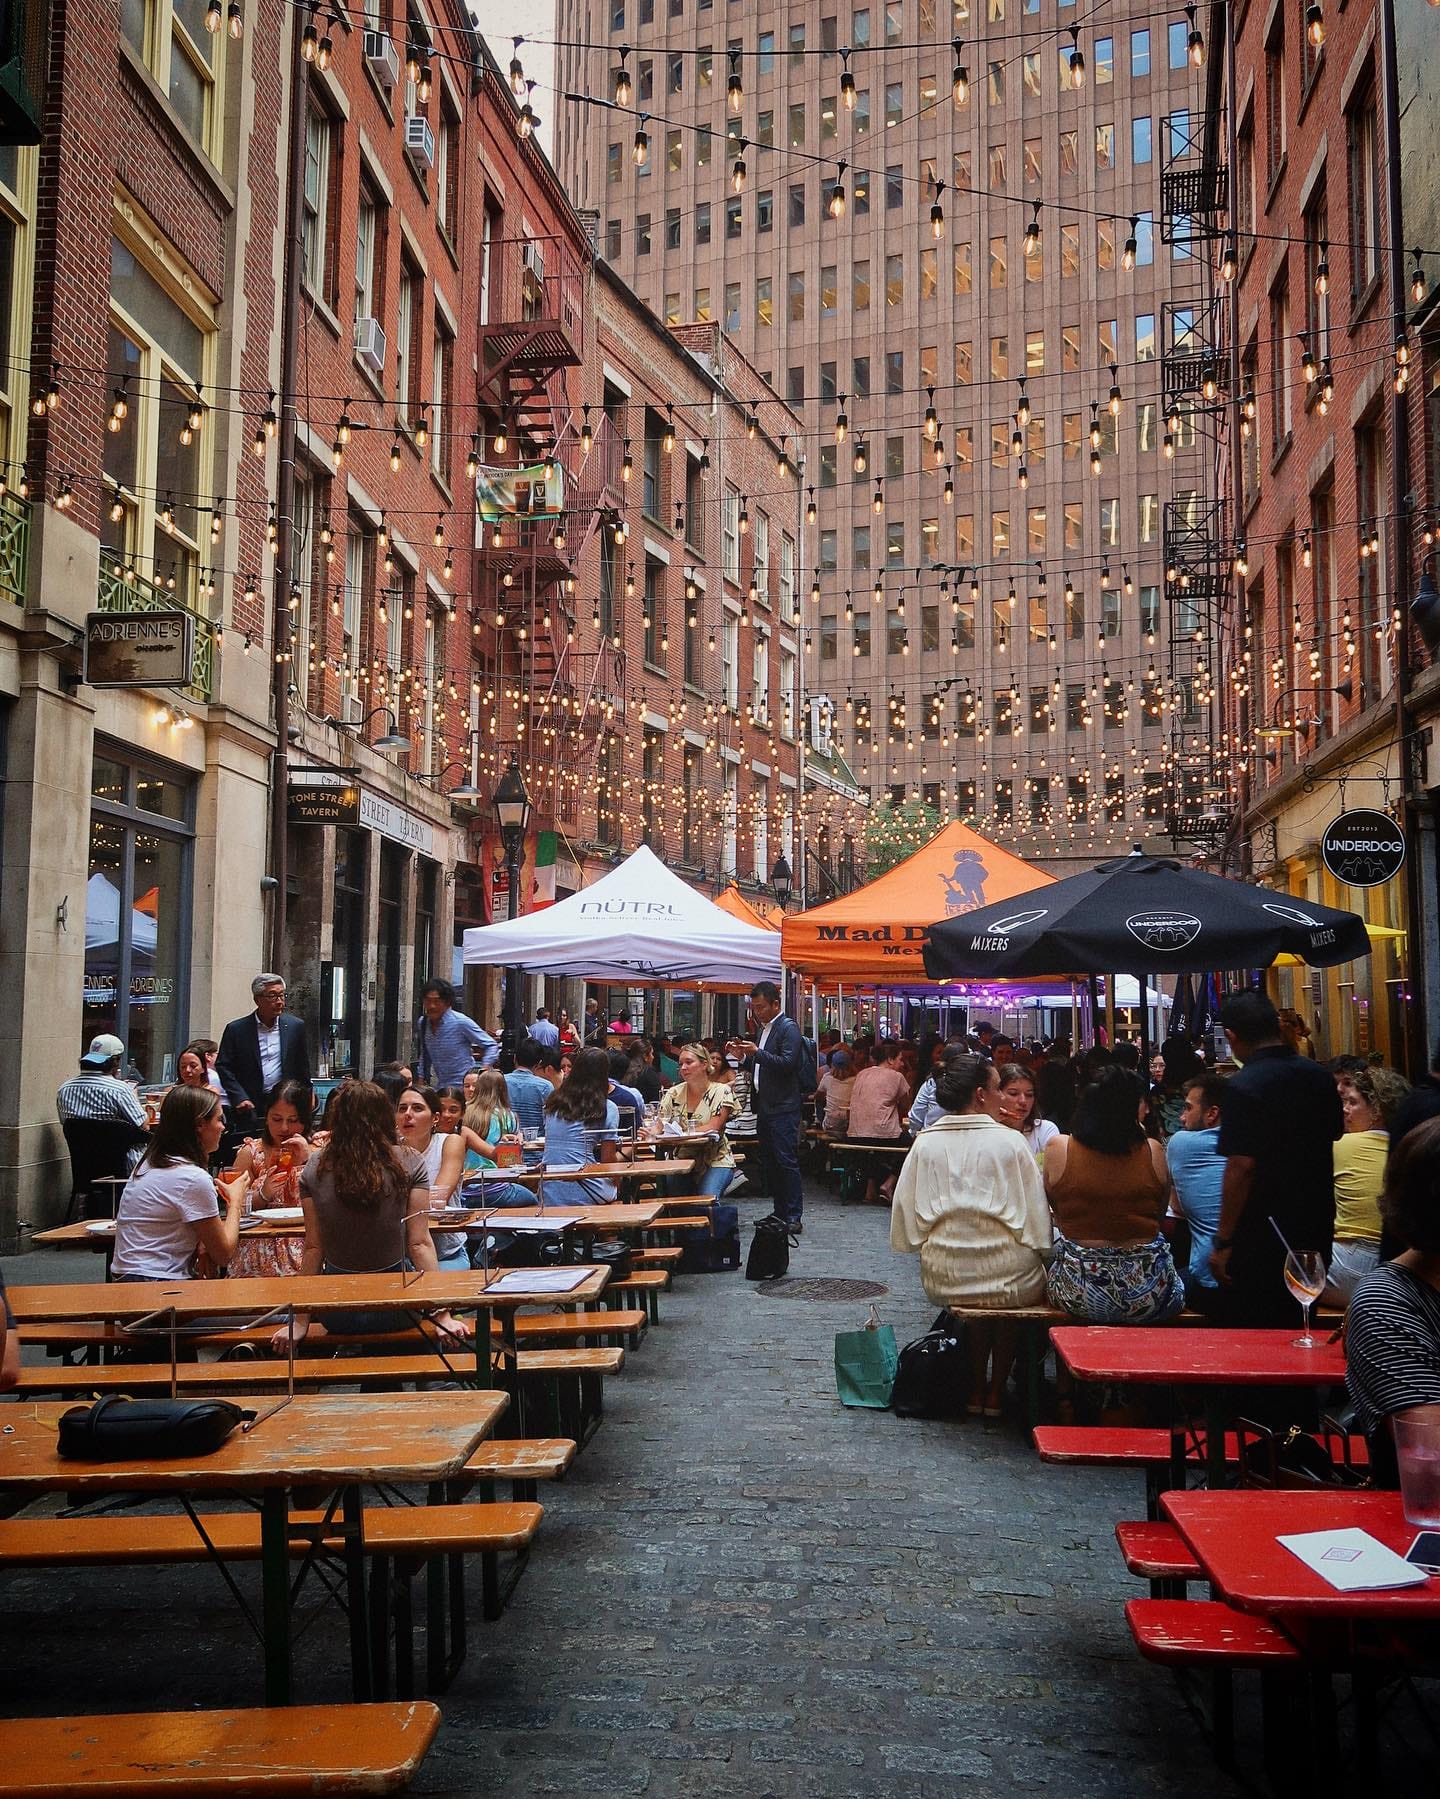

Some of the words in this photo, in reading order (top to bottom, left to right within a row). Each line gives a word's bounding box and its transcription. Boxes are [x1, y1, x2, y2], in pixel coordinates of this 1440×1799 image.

[89, 621, 182, 641] ADRIENNE'S
[320, 793, 356, 808] STREET
[301, 807, 339, 816] TAVERN
[361, 796, 390, 826] STREET
[1326, 840, 1403, 852] UNDERDOG
[816, 926, 895, 941] Mad
[1310, 929, 1336, 948] MIXERS
[970, 935, 1009, 951] MIXERS
